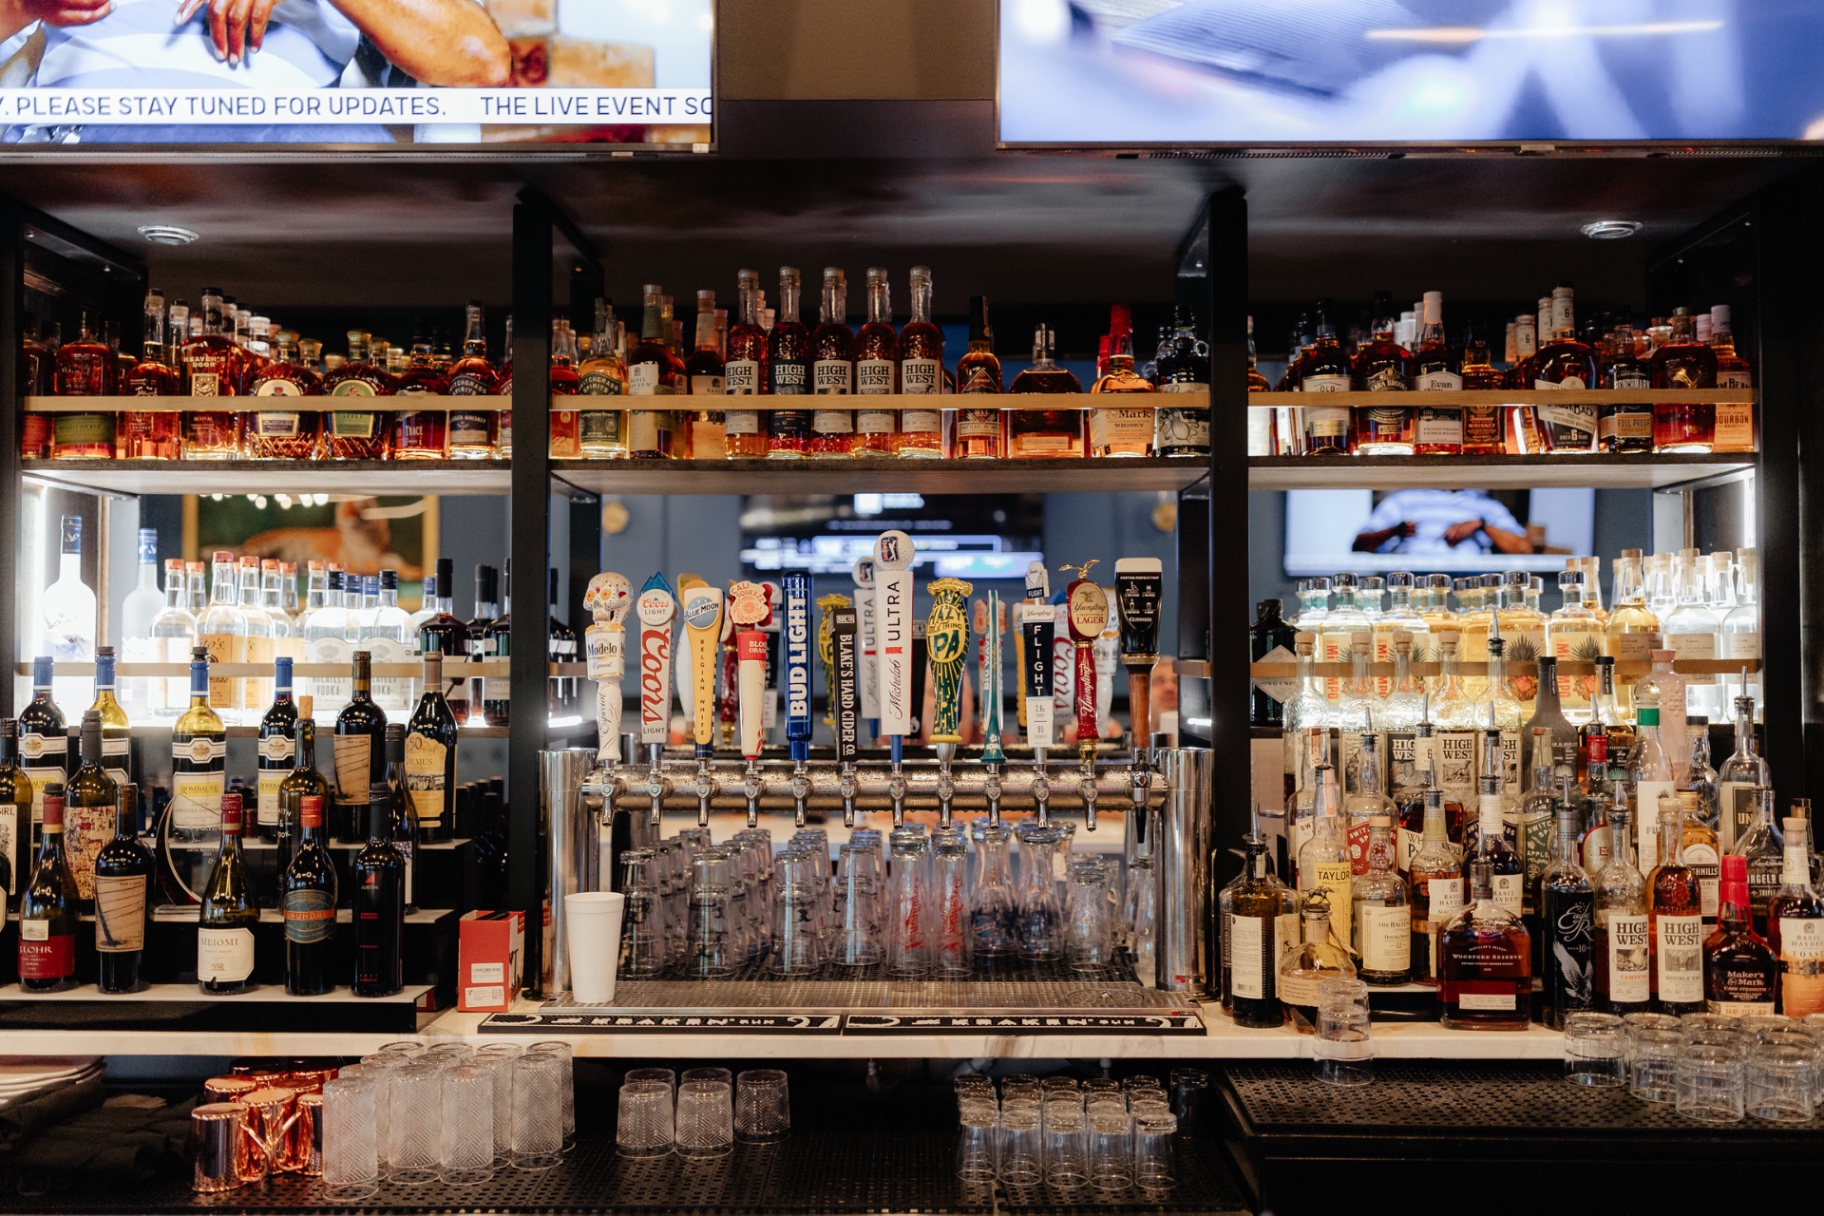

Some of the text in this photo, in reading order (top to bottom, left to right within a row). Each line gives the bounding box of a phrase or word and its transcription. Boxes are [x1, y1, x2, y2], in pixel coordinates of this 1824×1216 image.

[17, 97, 677, 115] PLEASE STAY TUNED FOR UPDATES. THE LIVE EVENT
[775, 365, 806, 375] HIGH
[817, 366, 847, 375] HIGH
[860, 366, 890, 375] HIGH
[906, 365, 935, 374] HIGH
[775, 375, 806, 385] WEST
[818, 376, 847, 385] WEST
[860, 376, 890, 385] WEST
[906, 375, 935, 384] WEST
[1430, 380, 1453, 389] Evan
[582, 381, 609, 394] SPIRITS
[1118, 409, 1151, 419] Mark
[1617, 419, 1651, 427] FULL PROOF
[1571, 429, 1578, 441] 6
[730, 582, 750, 595] CALI
[1028, 588, 1044, 598] FLIGHT
[735, 589, 766, 603] SQUEEZE
[643, 597, 669, 609] Coors
[1071, 602, 1106, 615] Yuengling
[683, 602, 719, 621] BLUE MOON
[887, 580, 901, 642] ULTRA
[864, 598, 875, 646] ULTRA
[1076, 616, 1104, 624] LAGER
[588, 642, 617, 657] Modelo
[788, 595, 808, 717] BUD LIGHT
[839, 634, 853, 677] BLAKE'S
[1033, 625, 1044, 696] FLIGHT
[642, 628, 670, 726] Coors
[316, 685, 342, 696] VODKA
[371, 684, 390, 696] ODKA
[841, 679, 854, 709] HARD
[888, 658, 903, 720] Michelob
[1079, 664, 1096, 718] Yuengling
[643, 727, 666, 735] LIGHT
[842, 711, 855, 742] CIDER
[1037, 725, 1044, 734] 95
[409, 737, 423, 751] 50
[1392, 739, 1416, 749] HIG
[1443, 739, 1473, 750] HIGH
[1503, 739, 1517, 750] GH
[1392, 750, 1416, 760] WES
[1443, 750, 1472, 760] WEST
[1503, 750, 1517, 760] ST
[180, 785, 220, 793] ROMBAUER
[1317, 871, 1350, 881] TAYLOR
[1664, 922, 1700, 934] HIGH
[200, 938, 239, 947] MEIOMI
[1664, 934, 1700, 945] WEST
[1578, 944, 1586, 952] 10
[1727, 970, 1765, 978] Maker's
[1738, 978, 1765, 986] Mark
